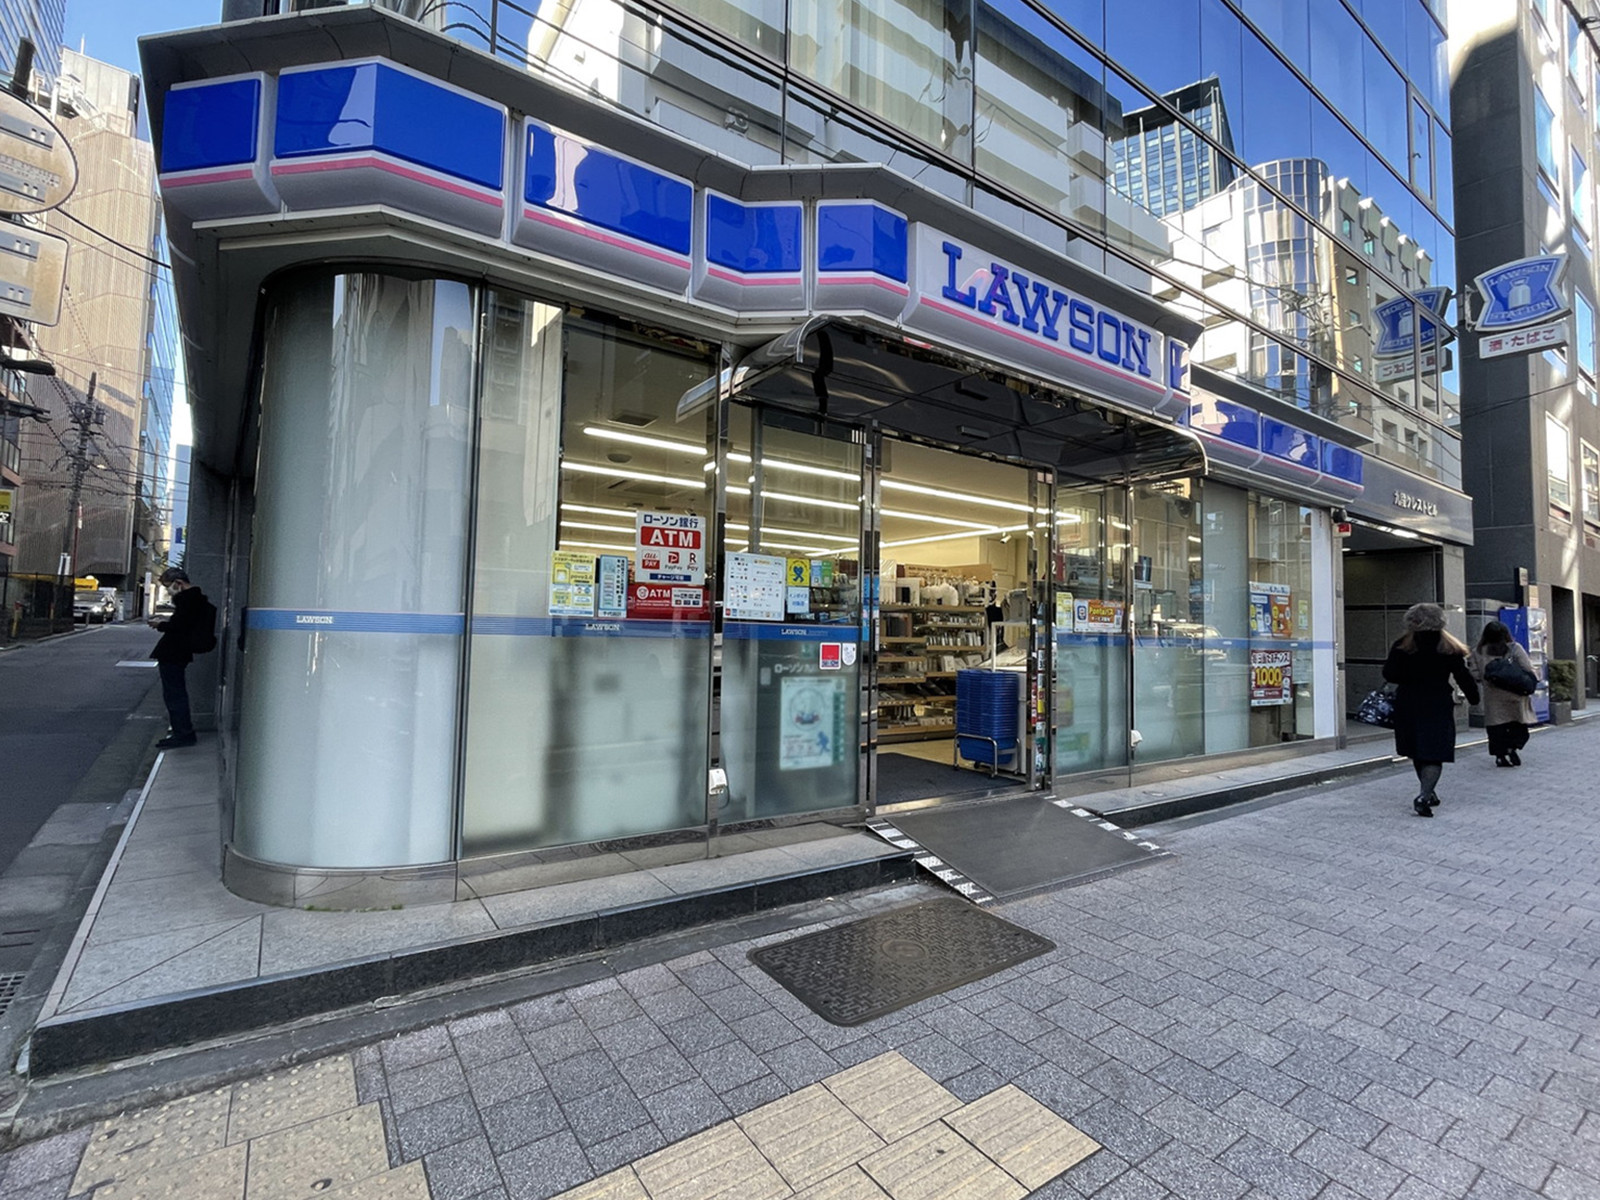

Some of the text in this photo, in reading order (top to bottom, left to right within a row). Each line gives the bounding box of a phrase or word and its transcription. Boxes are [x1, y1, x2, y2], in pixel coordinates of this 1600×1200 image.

[1489, 263, 1551, 286] LAWSON
[942, 241, 1152, 378] LAWSON
[1490, 299, 1553, 320] STATION
[1488, 328, 1556, 353] 酒・たばこ
[643, 514, 699, 529] ローソン銀行
[649, 529, 694, 548] ATM
[649, 588, 671, 598] ATM
[296, 615, 333, 624] LAWSON
[585, 623, 620, 631] LAWSON
